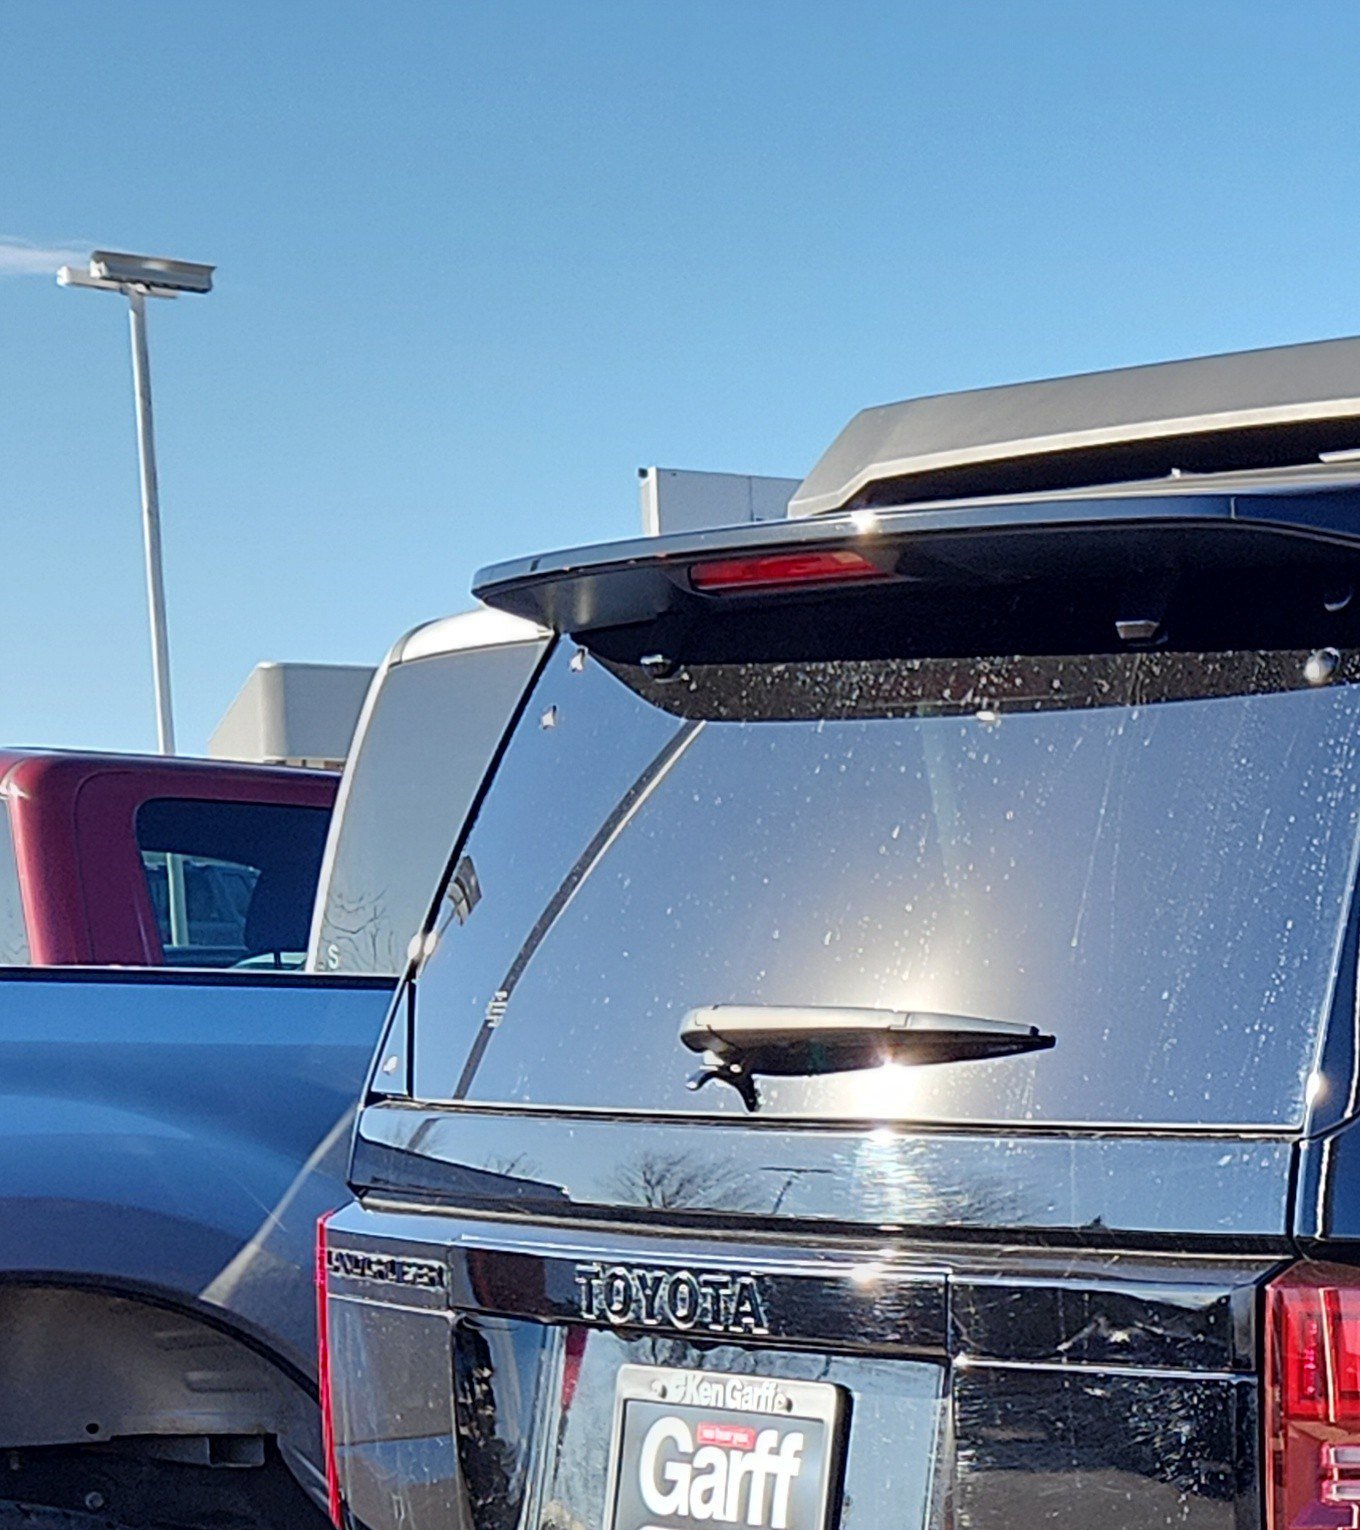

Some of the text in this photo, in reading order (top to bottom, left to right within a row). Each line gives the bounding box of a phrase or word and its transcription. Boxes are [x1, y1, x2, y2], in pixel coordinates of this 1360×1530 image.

[575, 1262, 769, 1335] TOYOTA
[684, 1374, 725, 1407] Ken
[639, 1416, 804, 1530] Garff
